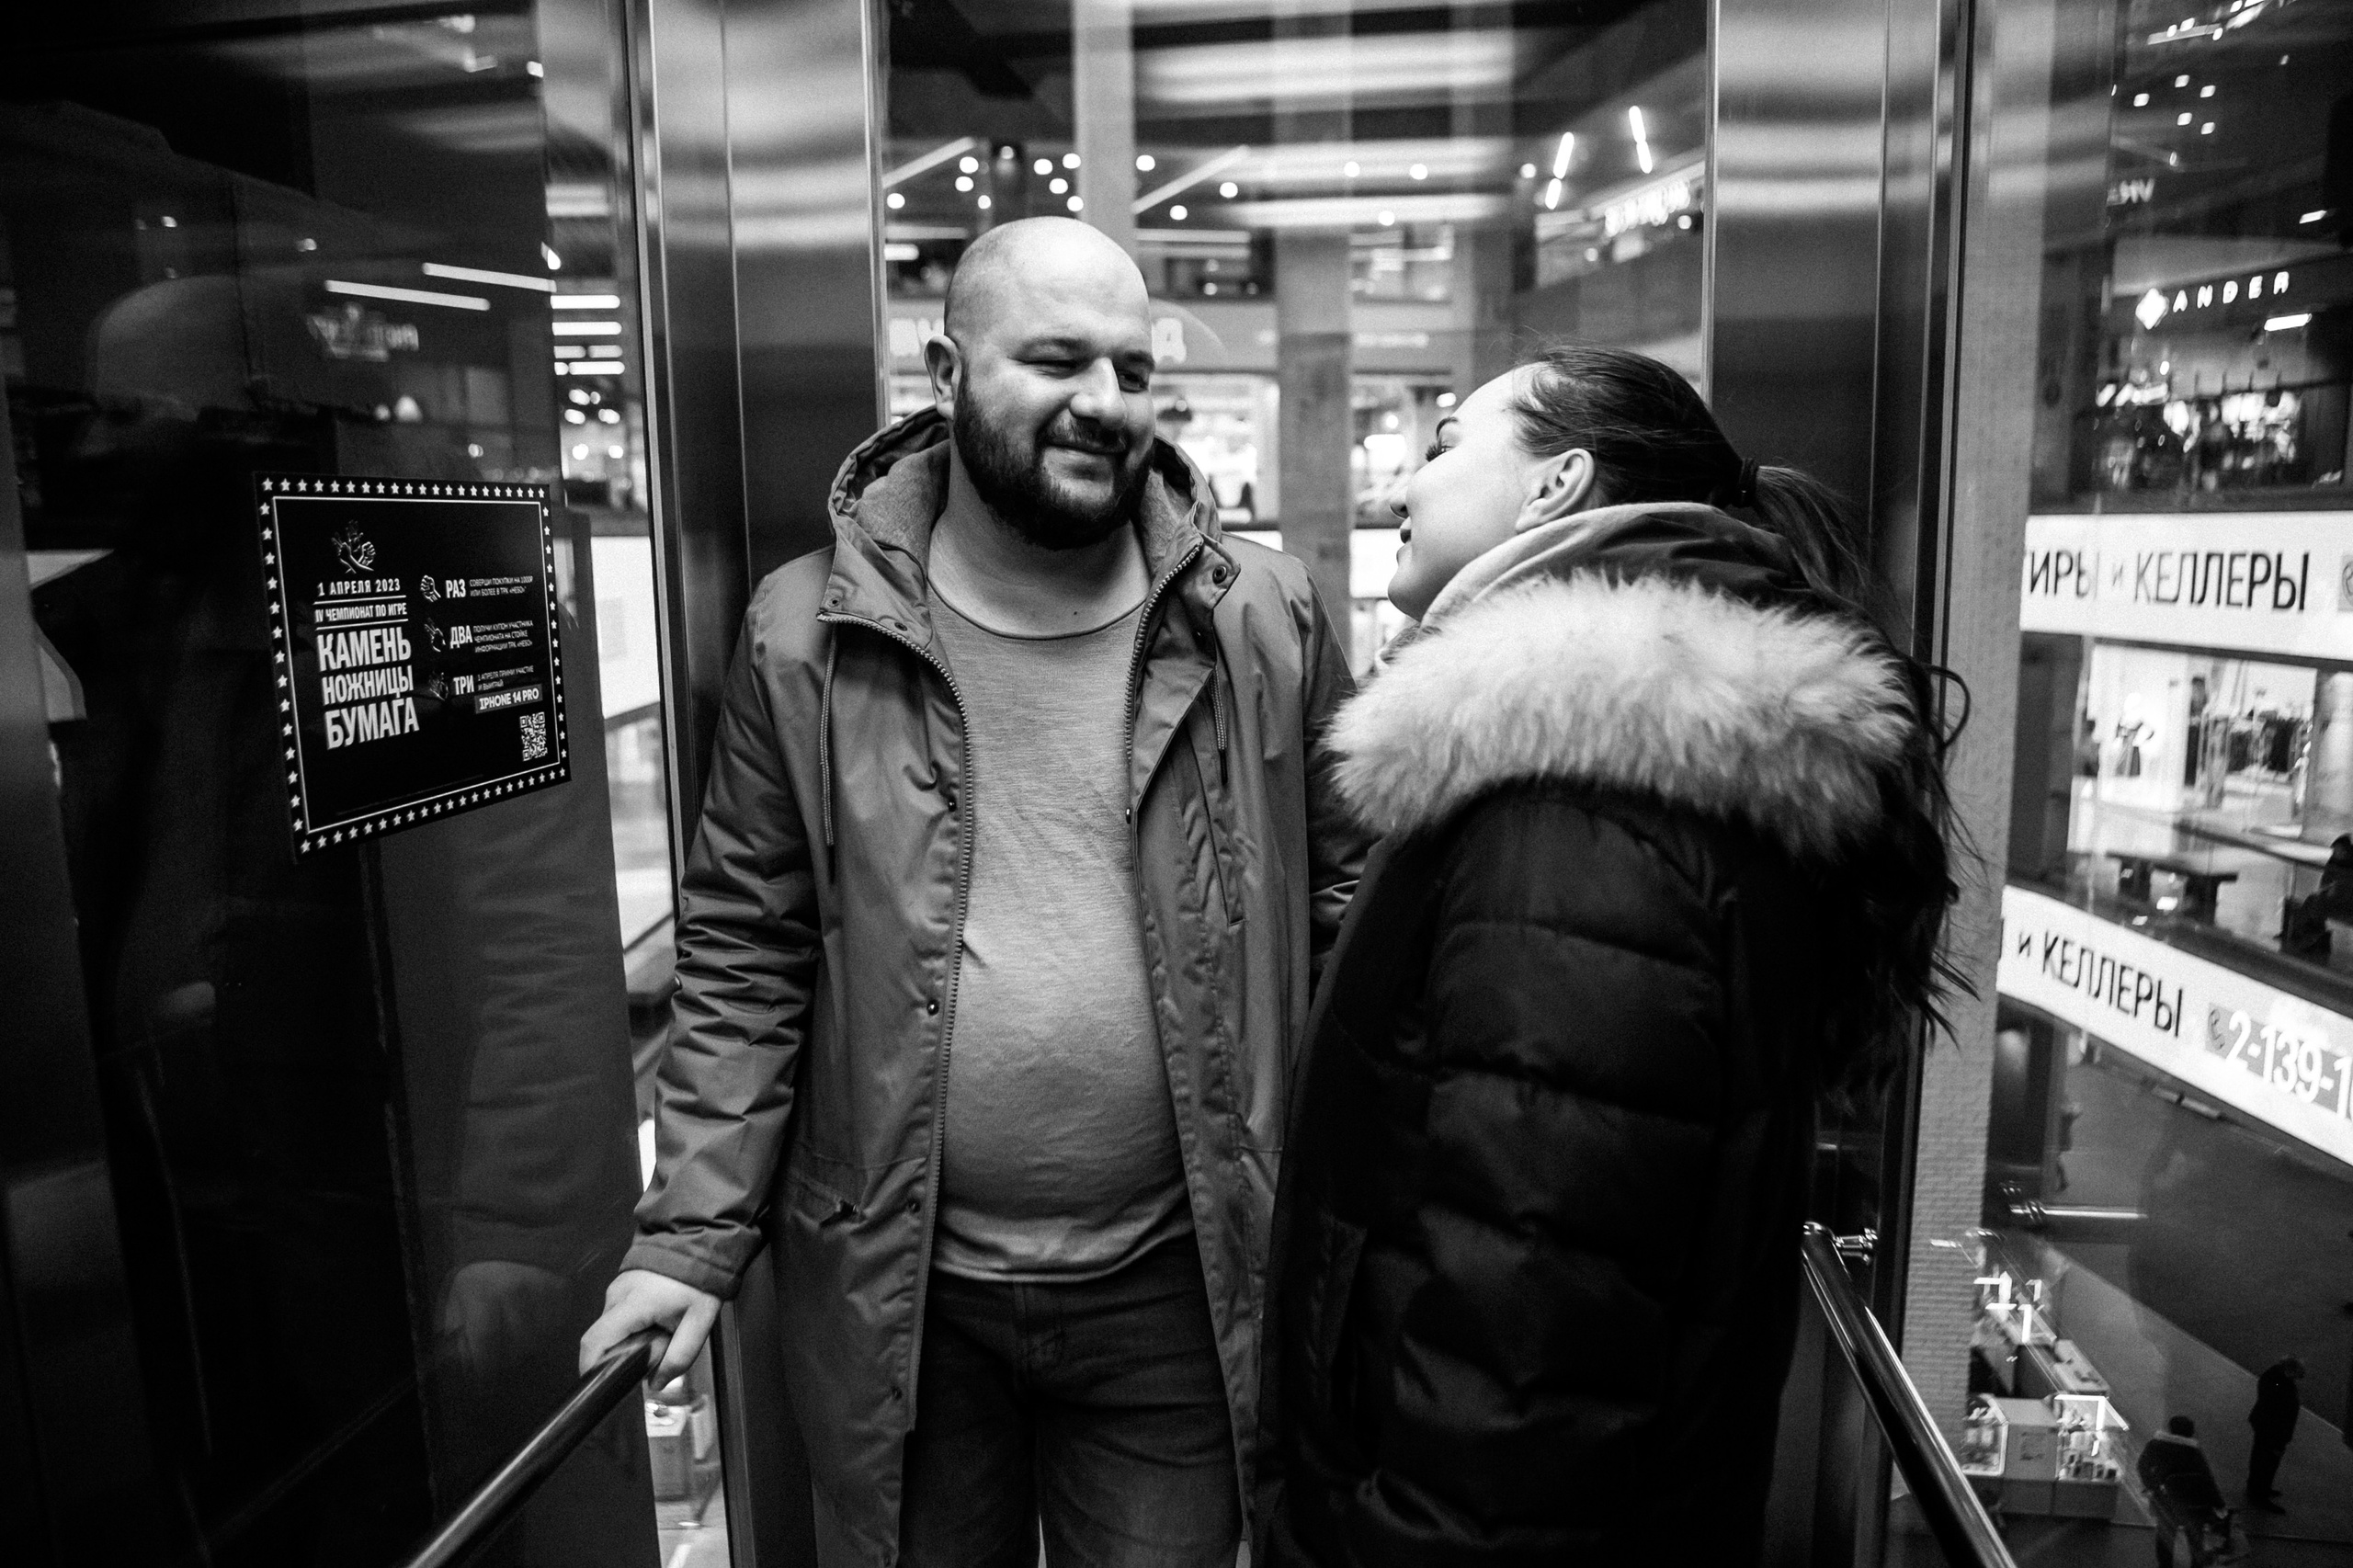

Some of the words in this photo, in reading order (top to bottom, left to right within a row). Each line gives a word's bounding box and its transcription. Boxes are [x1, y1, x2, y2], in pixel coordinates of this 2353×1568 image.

[317, 582, 325, 597] 1
[329, 579, 371, 596] АПРЕЛЯ
[375, 578, 401, 593] 2023
[445, 578, 466, 599] РАЗ
[2134, 551, 2311, 612] КЕЛЛЕРЫ
[314, 609, 324, 623] IV
[324, 606, 374, 622] ЧЕМПИОНАТ
[375, 604, 386, 618] ПО
[388, 602, 408, 617] ИГРЕ
[316, 626, 412, 673] КАМЕНЬ
[449, 625, 473, 649] ДВА
[322, 665, 414, 707] НОЖНИЦЫ
[453, 675, 474, 696] ТРИ
[479, 693, 512, 710] IPHONE
[512, 691, 522, 703] 14
[522, 687, 540, 701] PRO
[325, 697, 420, 750] БУМАГА
[2018, 931, 2031, 958] и
[2042, 930, 2183, 1039] КЕЛЛЕРЫ
[2225, 1009, 2353, 1123] 2-139-1
